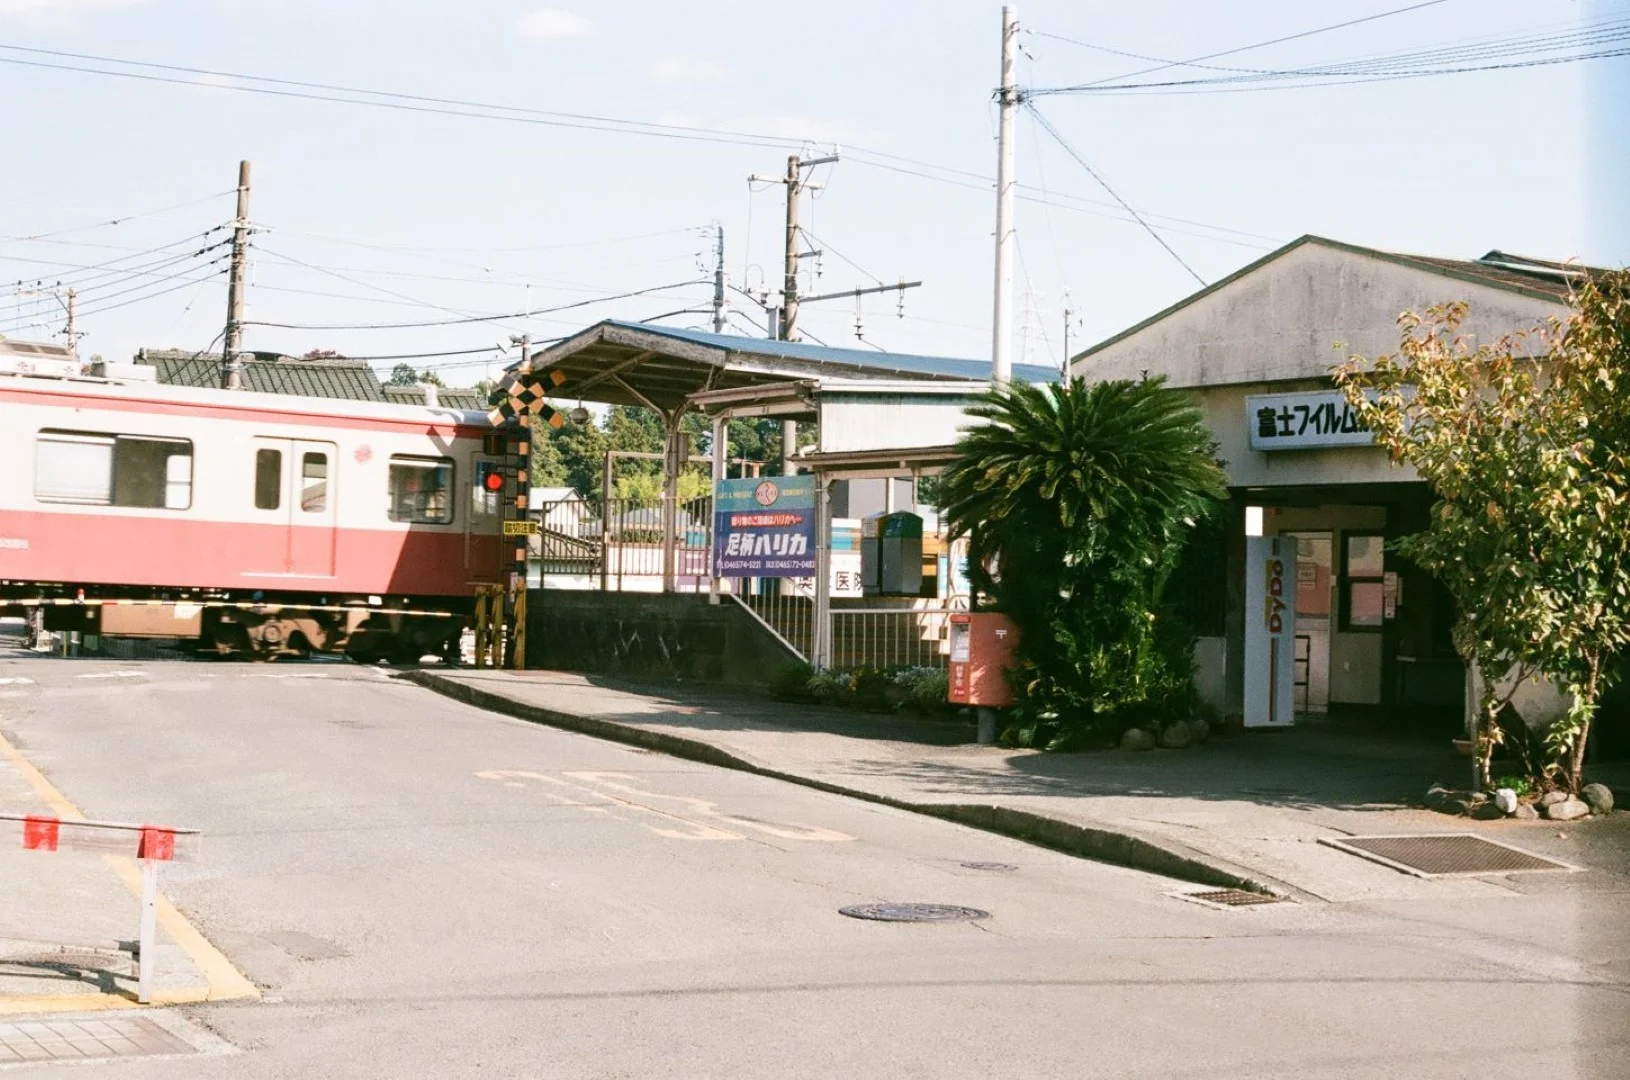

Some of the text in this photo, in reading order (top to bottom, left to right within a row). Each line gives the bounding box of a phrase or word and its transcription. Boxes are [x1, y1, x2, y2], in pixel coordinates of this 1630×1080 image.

[1257, 402, 1371, 438] 富士フイルム
[725, 532, 807, 556] 足柄ハリカ
